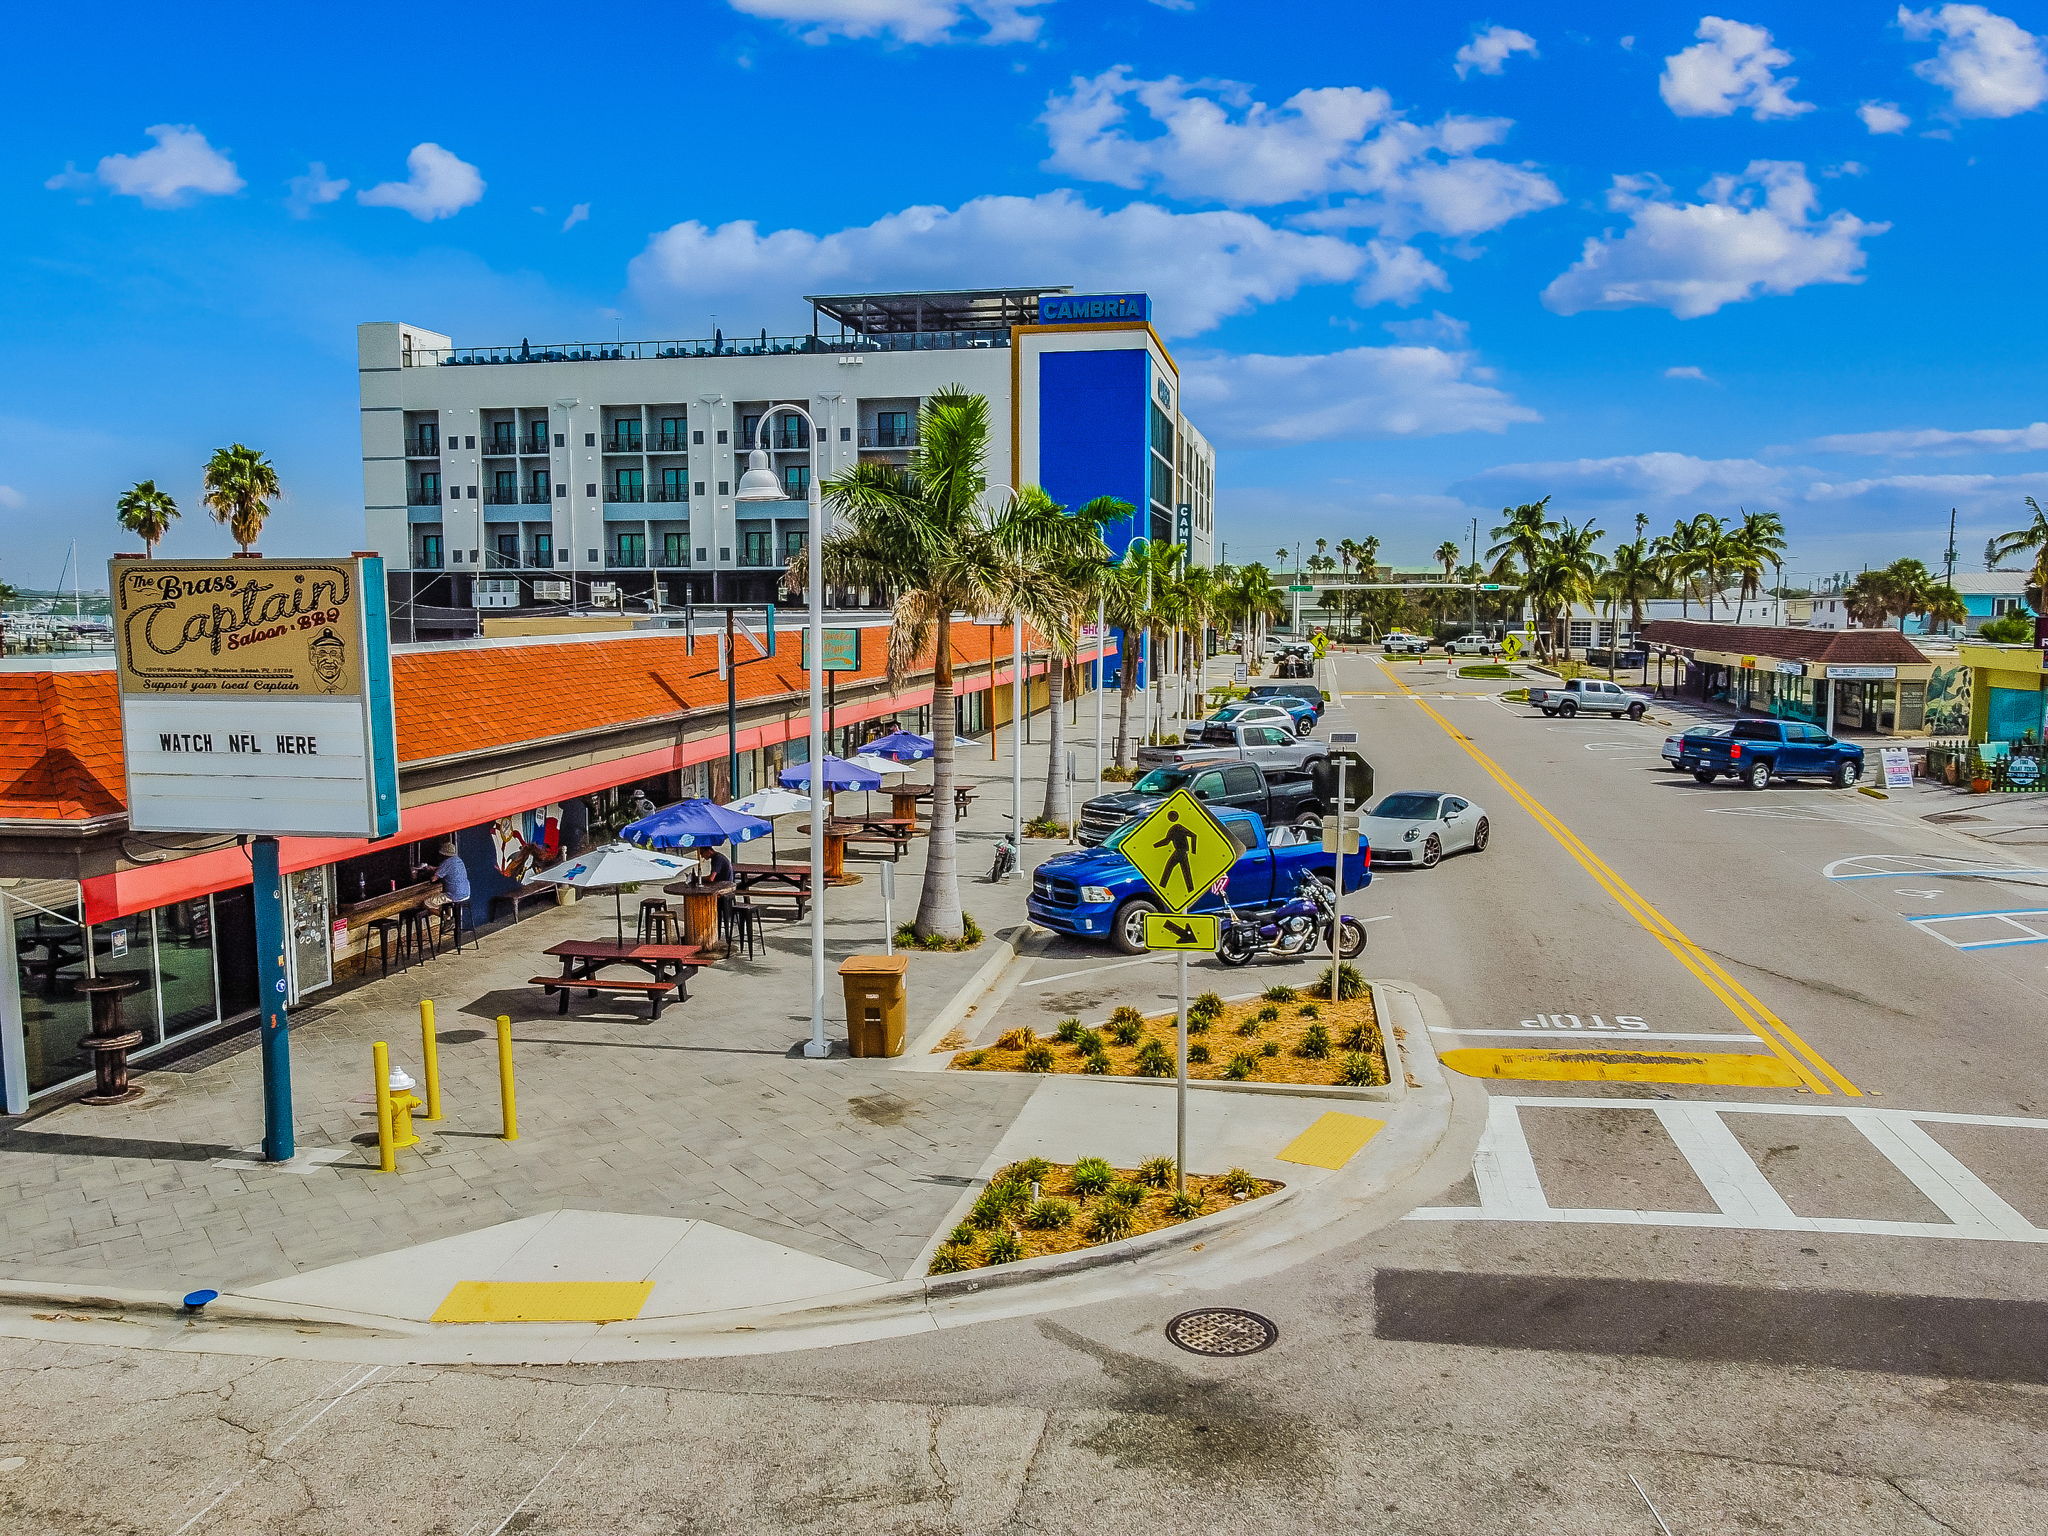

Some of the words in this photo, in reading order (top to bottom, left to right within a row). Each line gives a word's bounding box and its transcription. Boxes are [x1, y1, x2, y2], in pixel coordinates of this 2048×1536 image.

[128, 574, 156, 589] The
[157, 574, 239, 600] Brass
[138, 574, 349, 656] Captain
[227, 622, 289, 650] Saloon
[296, 607, 341, 631] BBQ
[142, 679, 188, 692] Support
[191, 680, 218, 692] your
[221, 680, 250, 690] local
[253, 680, 300, 693] Captain
[159, 733, 213, 752] WATCH
[228, 734, 262, 753] NFL
[276, 735, 318, 755] HERE
[1519, 1013, 1650, 1031] STOP
